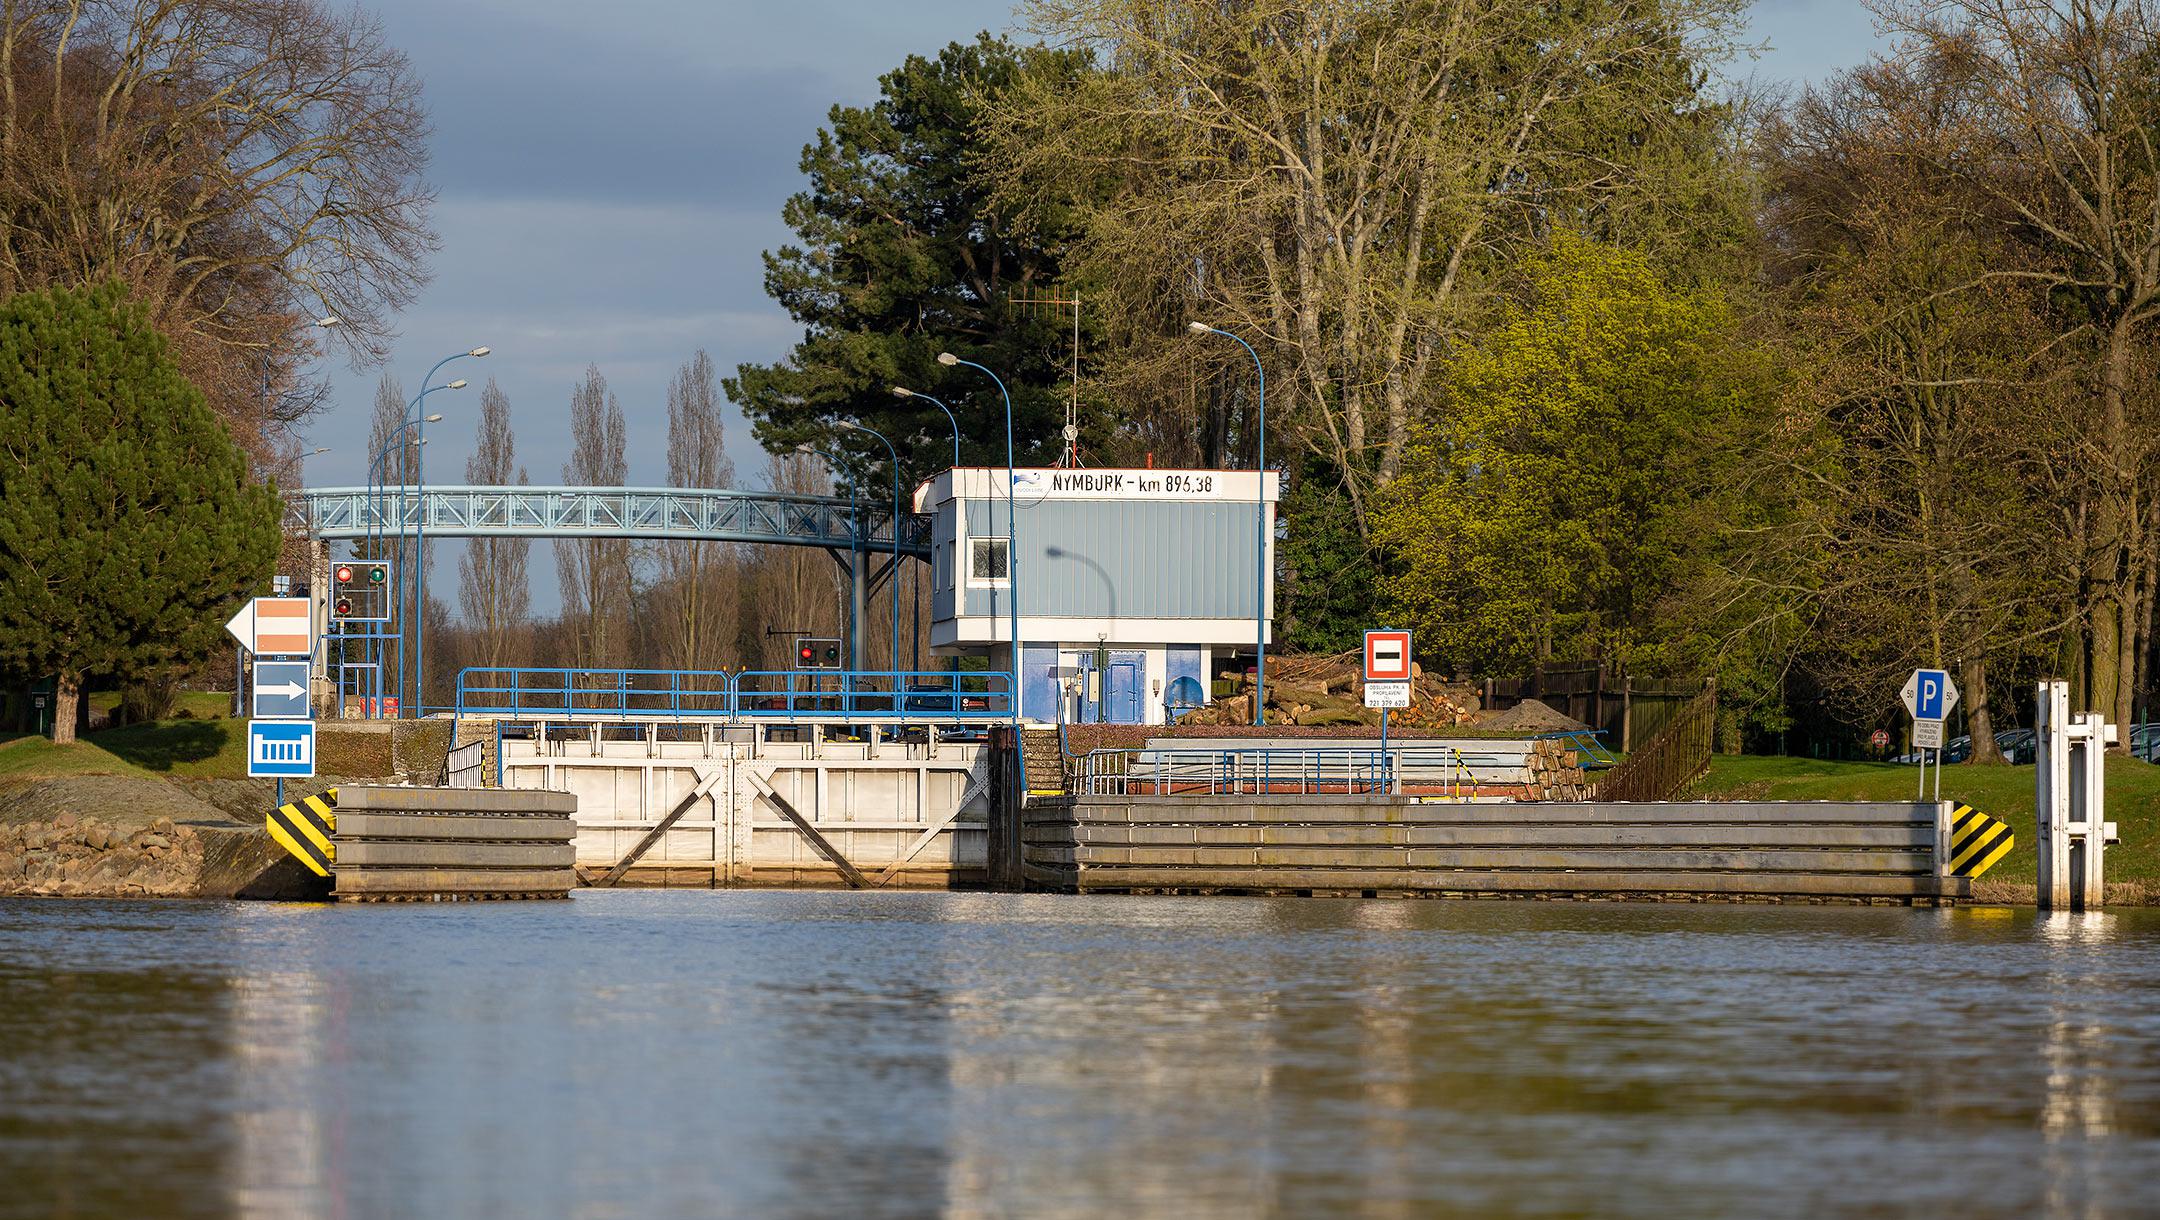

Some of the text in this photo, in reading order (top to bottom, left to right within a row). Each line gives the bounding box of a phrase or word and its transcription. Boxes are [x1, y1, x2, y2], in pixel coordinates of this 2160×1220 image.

[1053, 474, 1123, 491] NYMBURK
[1139, 475, 1160, 492] km
[1166, 475, 1212, 493] 896,38
[1906, 680, 1953, 711] 50 P 50
